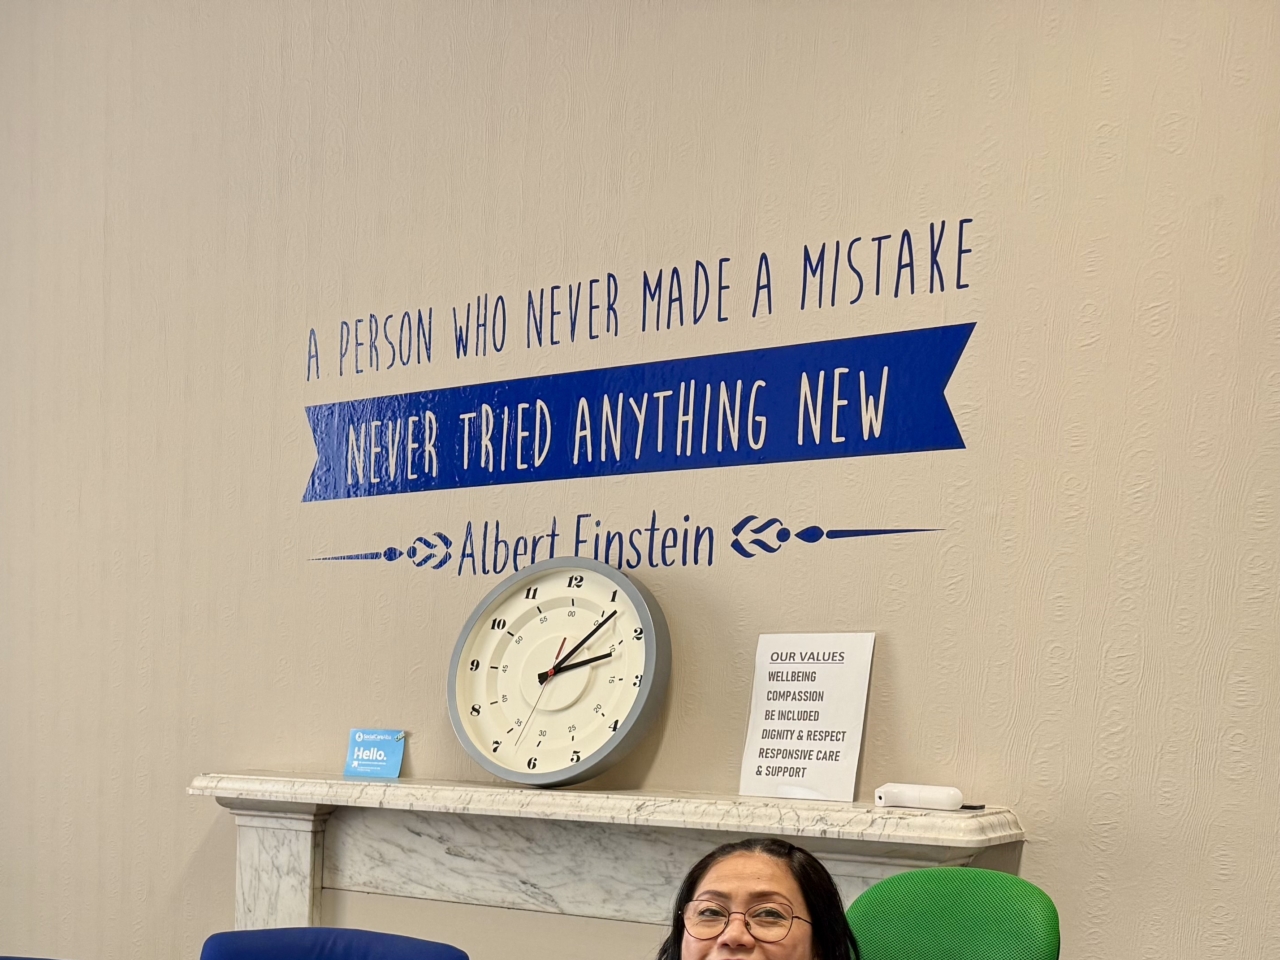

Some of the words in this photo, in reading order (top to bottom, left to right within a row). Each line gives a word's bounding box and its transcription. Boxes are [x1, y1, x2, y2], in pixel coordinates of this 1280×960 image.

[306, 327, 320, 382] A
[339, 306, 433, 377] PERSON
[452, 292, 507, 360] WHO
[526, 272, 619, 349] NEVER
[641, 257, 731, 332] MADE
[751, 252, 772, 319] A
[800, 218, 974, 311] MISTAKE
[346, 410, 438, 485] NEVER
[459, 398, 552, 473] TRIED
[572, 378, 767, 465] ANYTHING
[797, 365, 889, 446] NEW
[457, 515, 560, 576] Albert
[566, 575, 584, 588] 12
[524, 586, 538, 600] 11
[609, 589, 618, 602] 1
[490, 617, 507, 630] 10
[539, 615, 548, 624] 55
[514, 635, 523, 645] 50
[632, 627, 644, 641] 2
[770, 651, 796, 662] OUR
[799, 651, 845, 662] VALUES
[469, 659, 480, 672] 9
[501, 664, 509, 673] 45
[633, 674, 643, 687] 3
[768, 670, 817, 682] WELLBEING
[766, 690, 824, 702] COMPASSION
[470, 703, 481, 717] 8
[593, 703, 602, 713] 20
[764, 710, 776, 721] BE
[777, 710, 820, 722] INCLUDED
[567, 724, 577, 733] 25
[608, 719, 619, 732] 4
[761, 728, 795, 741] DIGNITY
[796, 730, 804, 741] &
[806, 730, 847, 742] RESPECT
[353, 746, 387, 760] Hello.
[492, 740, 502, 753] 7
[570, 750, 581, 763] 5
[758, 748, 814, 761] RESPONSIVE
[815, 749, 841, 762] CARE
[527, 757, 537, 770] 6
[755, 765, 763, 776] &
[765, 766, 807, 778] SUPPORT
